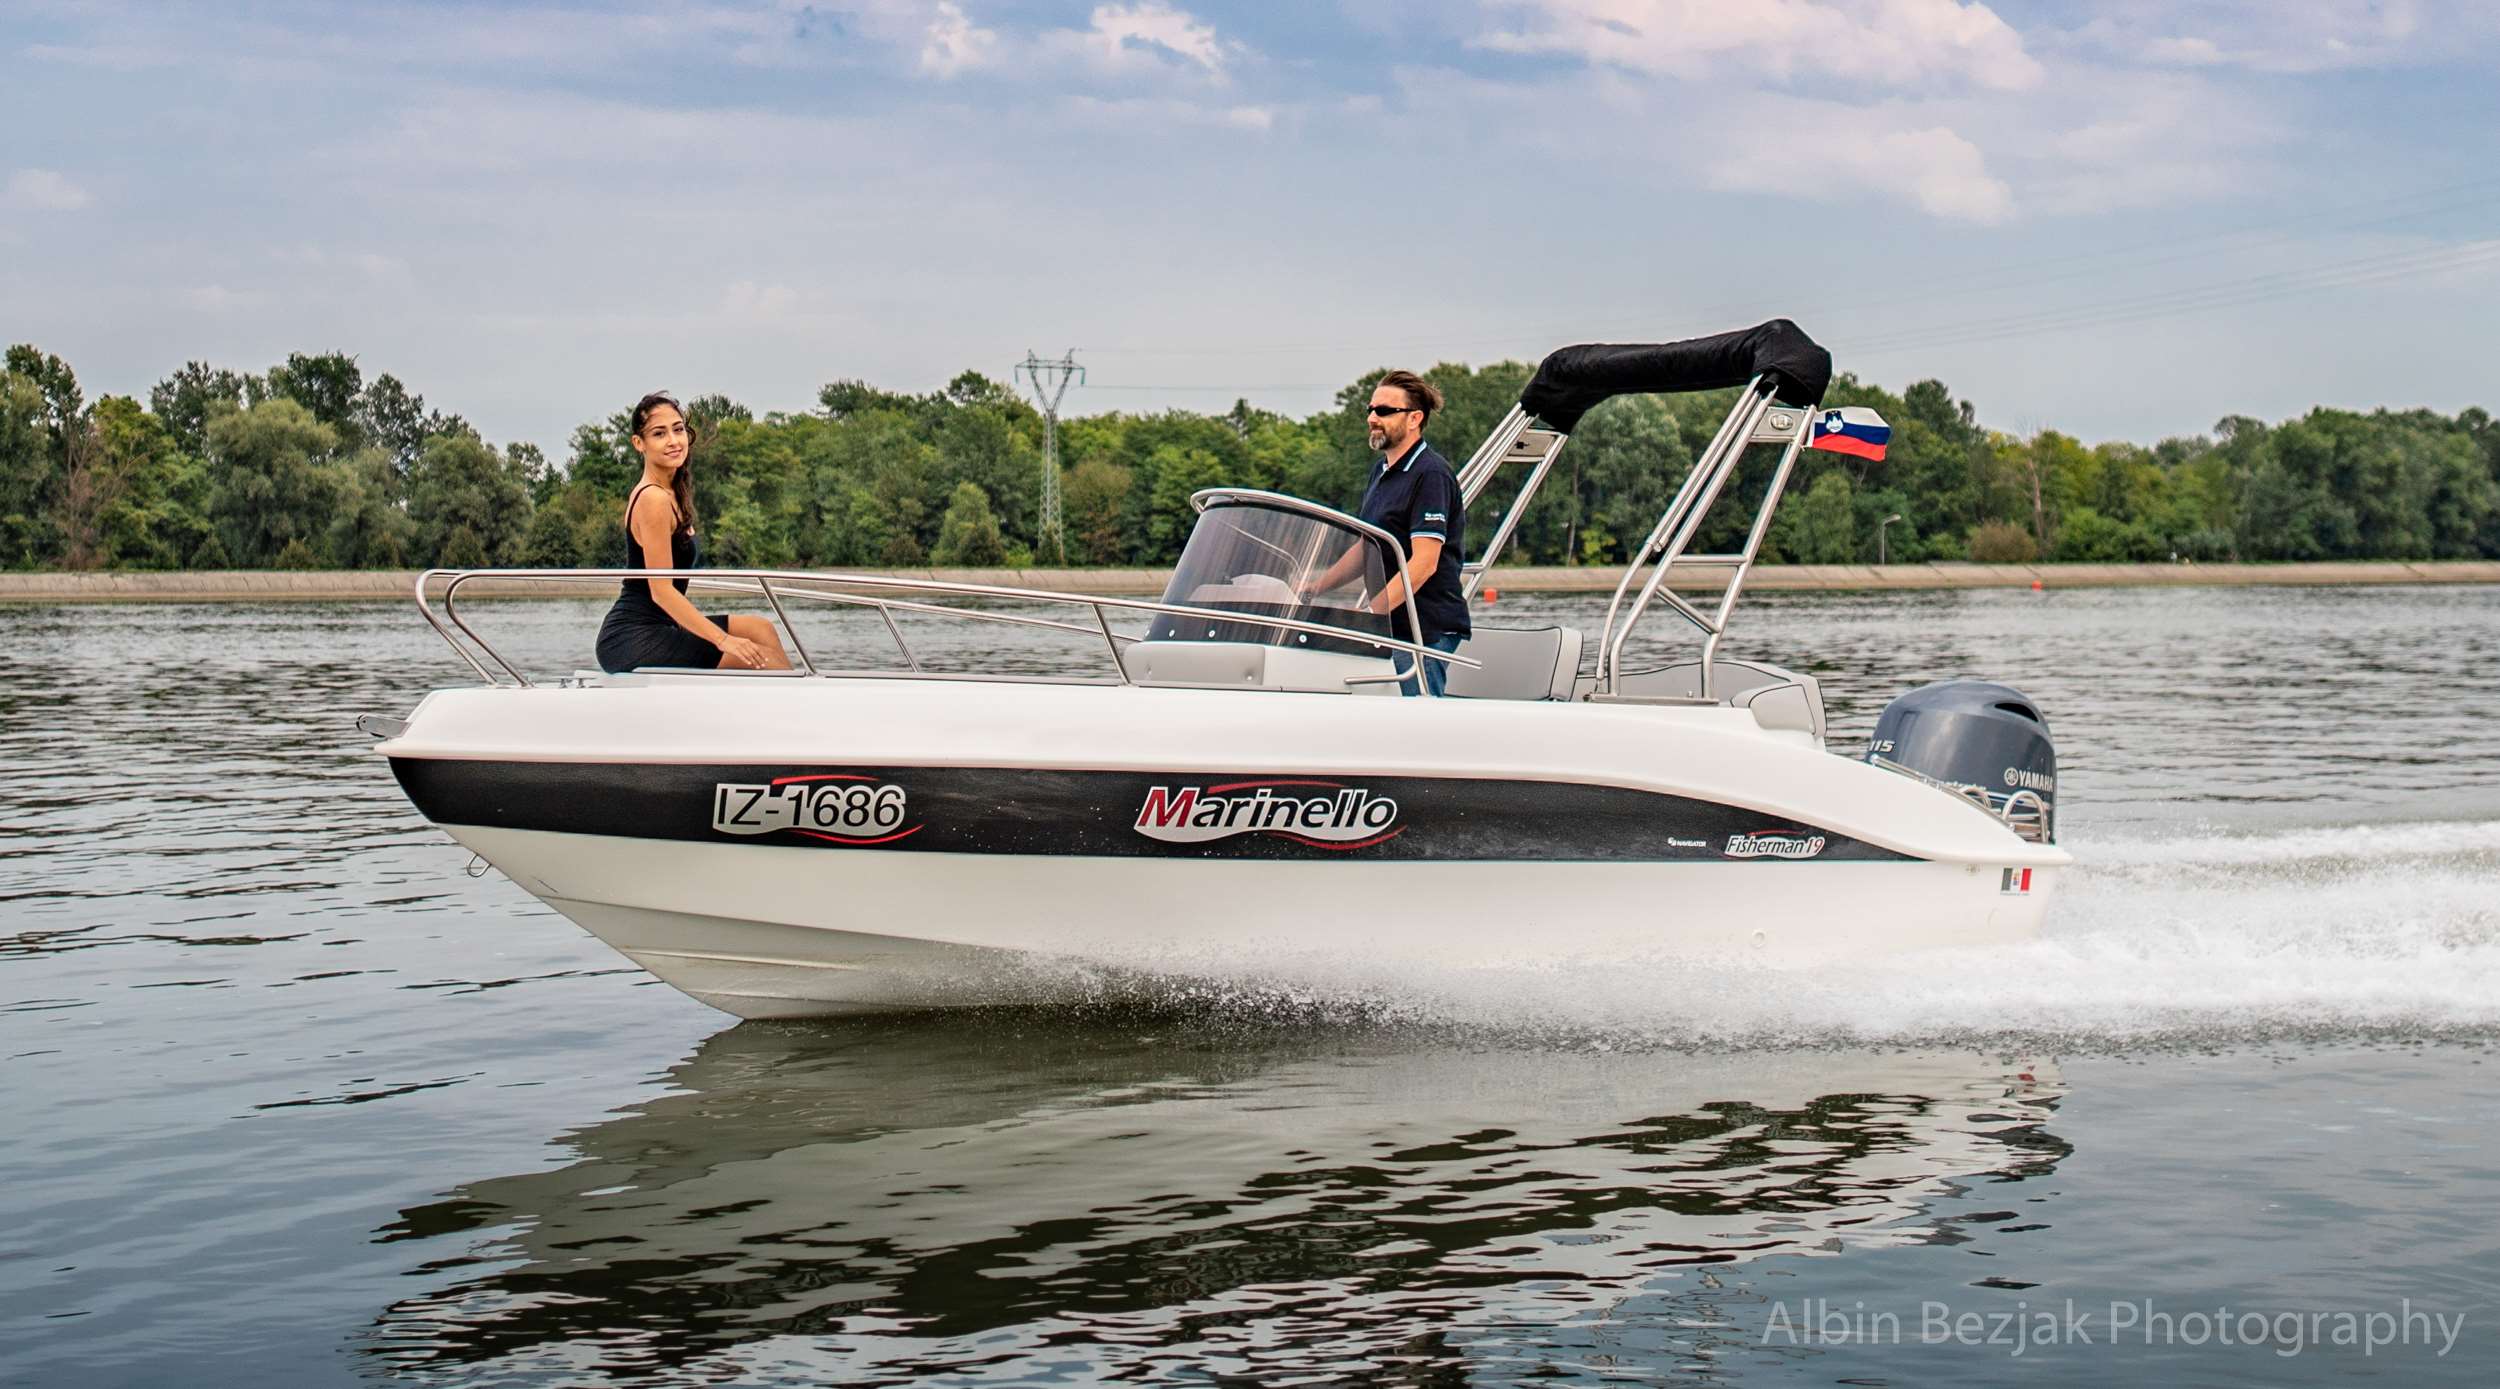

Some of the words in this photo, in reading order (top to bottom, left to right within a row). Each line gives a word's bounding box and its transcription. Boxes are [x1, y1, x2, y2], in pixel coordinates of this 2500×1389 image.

[1869, 740, 1896, 752] 115
[2018, 769, 2054, 792] YAMAHA
[716, 787, 902, 828] IZ-1686
[1136, 787, 1397, 829] Marinello
[1726, 836, 1805, 854] Fisherman
[1807, 837, 1824, 852] 19
